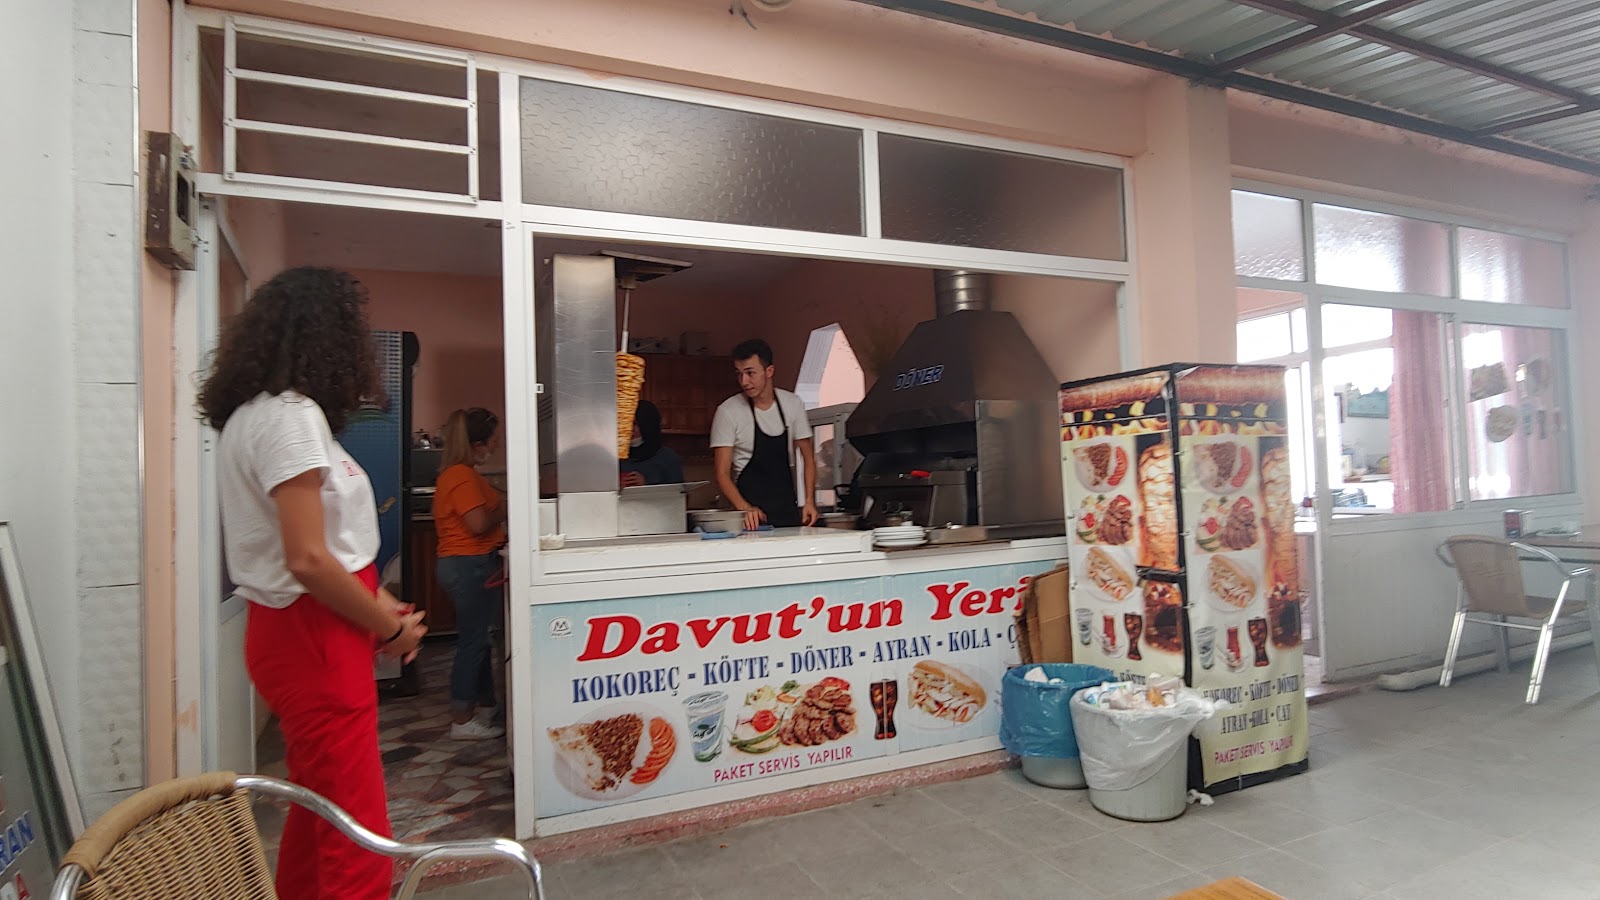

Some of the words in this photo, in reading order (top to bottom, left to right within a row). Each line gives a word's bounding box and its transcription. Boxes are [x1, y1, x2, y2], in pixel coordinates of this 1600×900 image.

[893, 364, 944, 391] DÖNER
[926, 576, 1031, 620] Yeri
[572, 666, 680, 703] KOKOREÇ
[703, 655, 769, 686] KÖFTE
[790, 645, 853, 674] DÖNER
[873, 635, 931, 662] AYRAN
[948, 628, 991, 652] KOLA
[713, 763, 754, 783] PAKET
[758, 753, 800, 775] SERVİS
[807, 747, 853, 765] YAPILIR
[1215, 747, 1239, 765] PAKET
